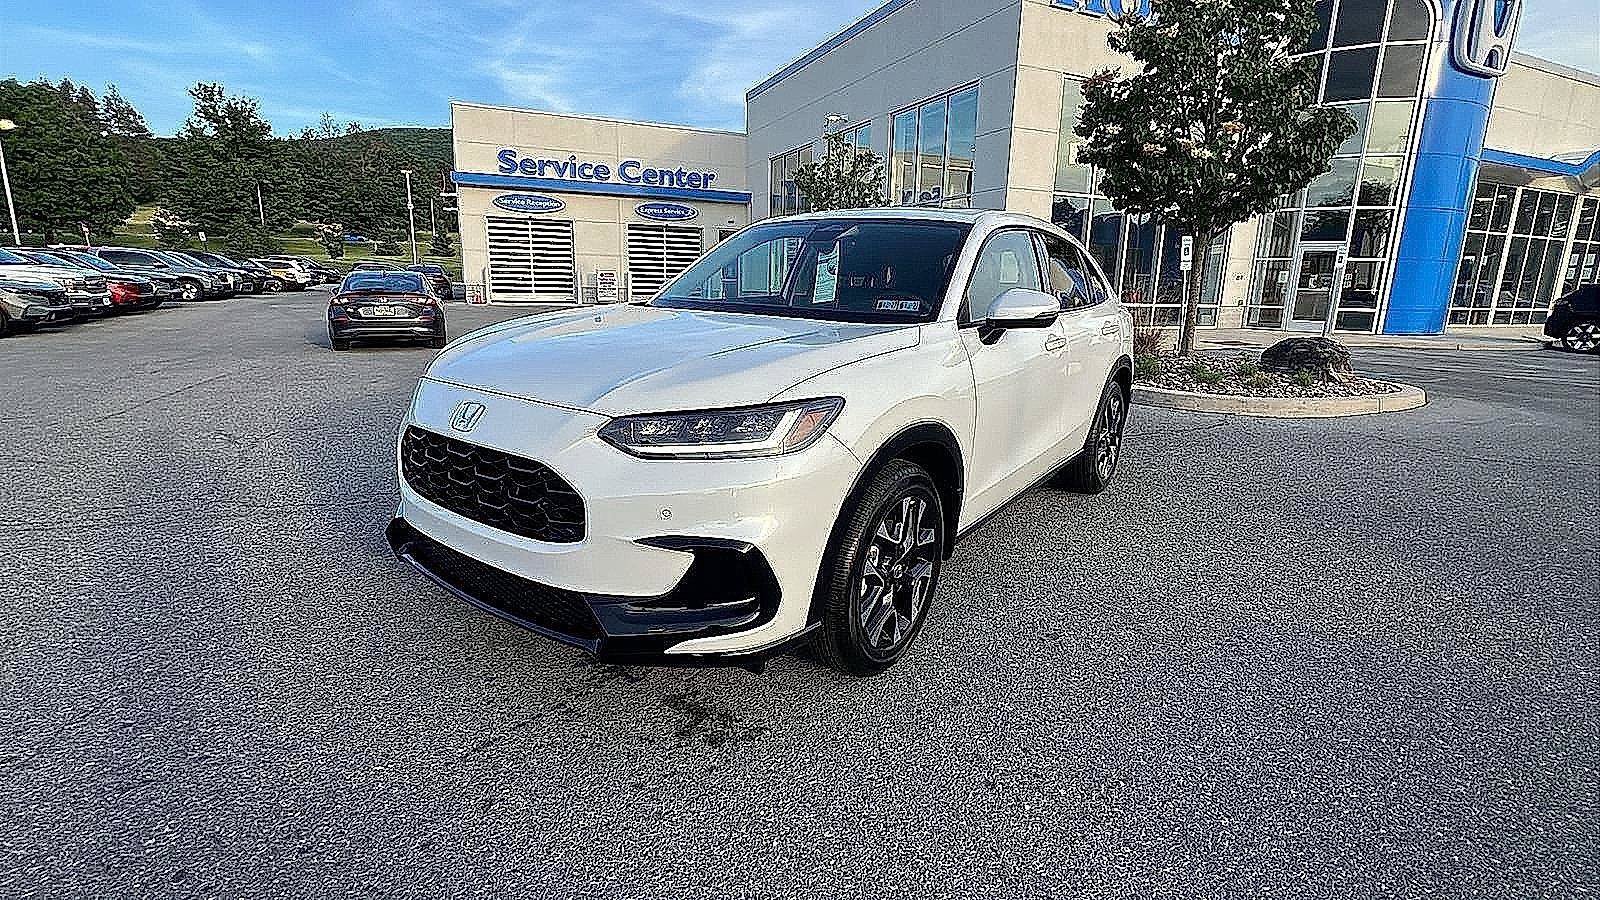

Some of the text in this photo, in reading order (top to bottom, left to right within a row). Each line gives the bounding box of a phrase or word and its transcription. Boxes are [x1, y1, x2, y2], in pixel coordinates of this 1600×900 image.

[497, 148, 716, 189] Service Center
[499, 197, 561, 208] Service Reception
[640, 206, 686, 215] Express Service
